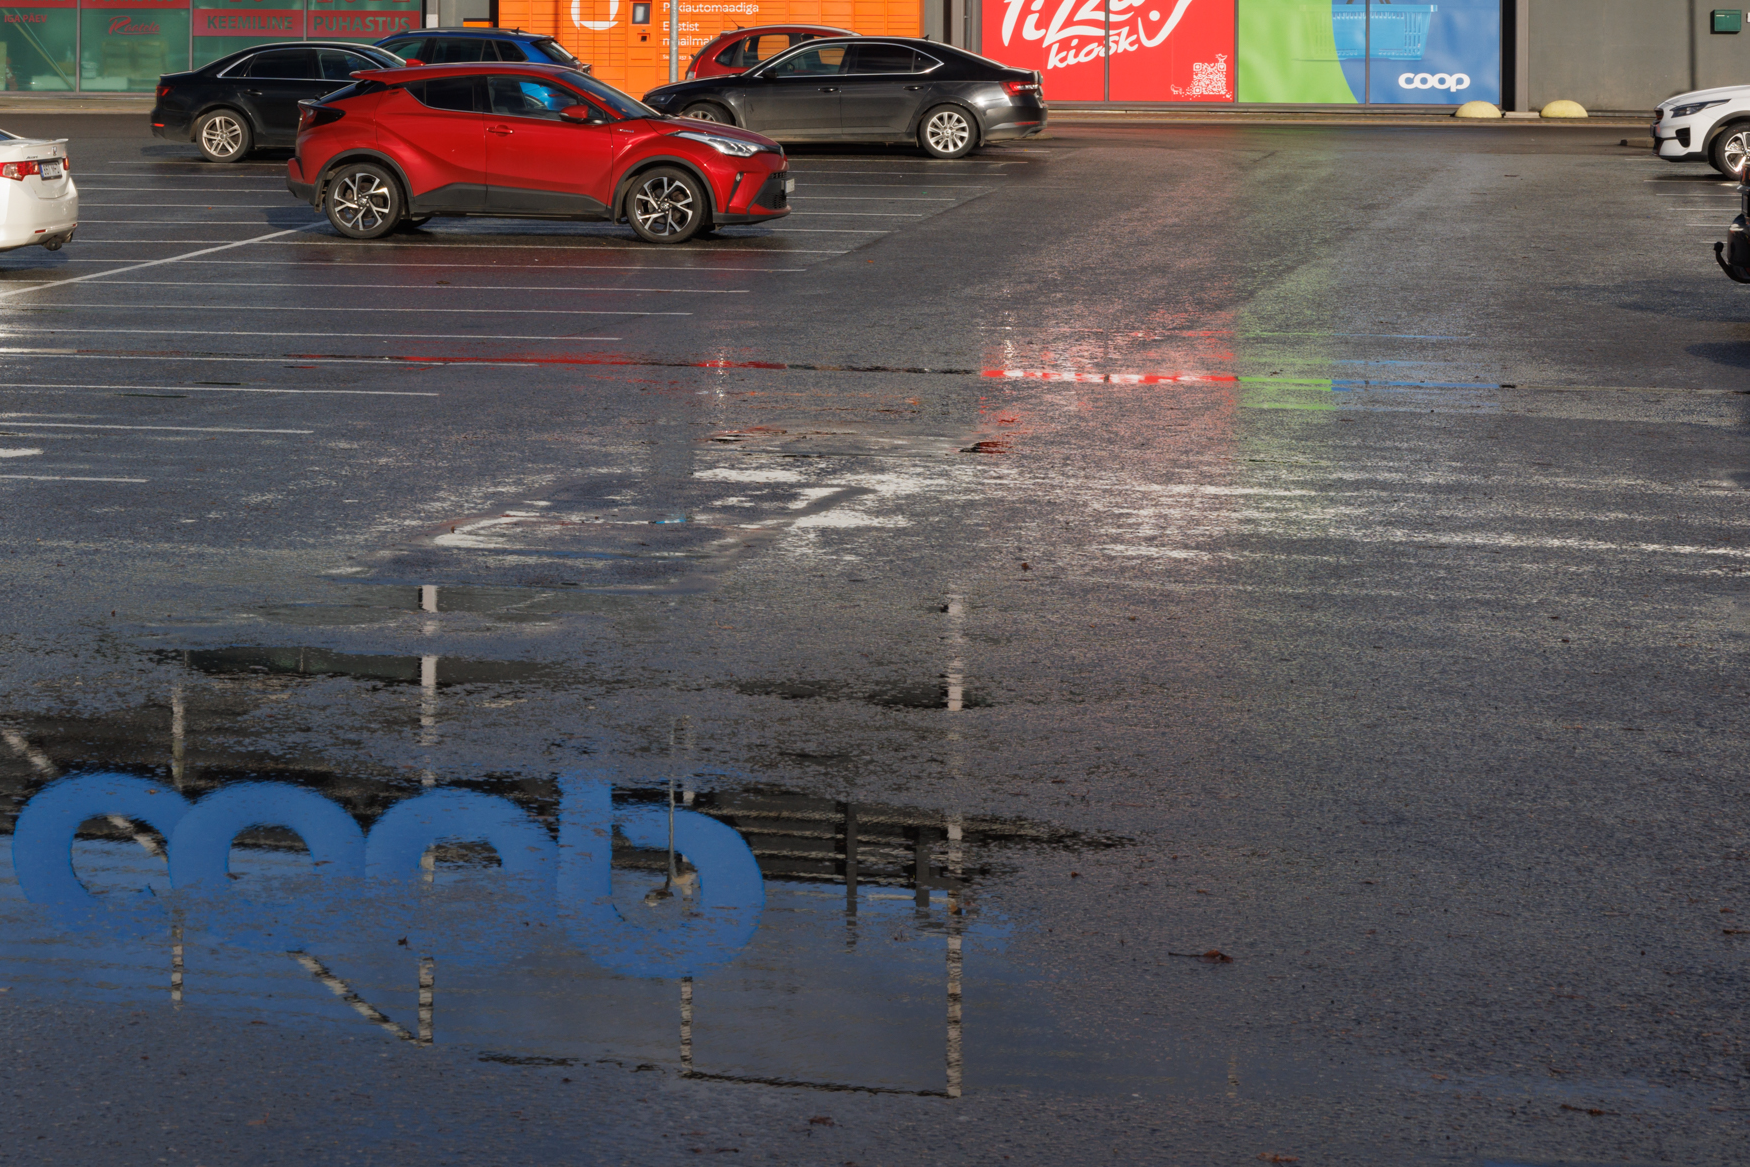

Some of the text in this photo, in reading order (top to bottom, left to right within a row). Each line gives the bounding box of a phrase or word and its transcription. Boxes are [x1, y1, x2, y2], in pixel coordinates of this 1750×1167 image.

[663, 2, 759, 15] Pkiautomaadiga
[3, 13, 48, 23] IGA PÄEV
[207, 16, 411, 32] KEEMILINE PUHASTUS
[663, 21, 700, 32] Estist
[1046, 26, 1139, 70] kiosk
[1398, 73, 1471, 92] coop
